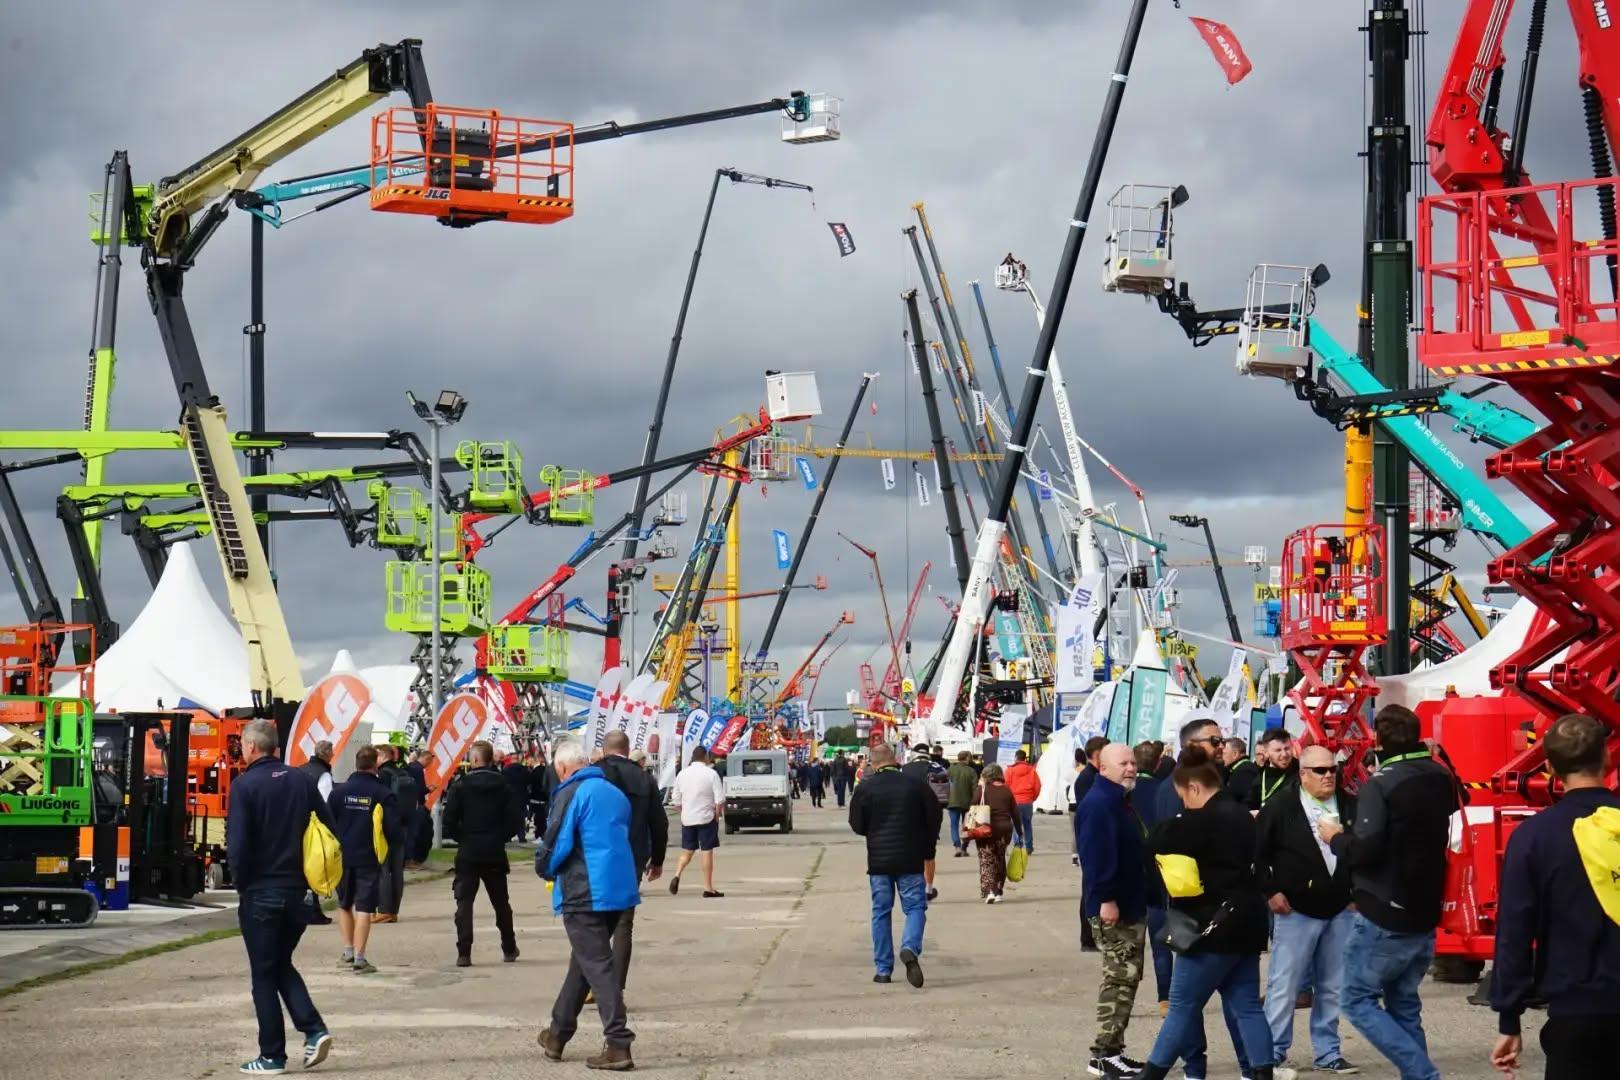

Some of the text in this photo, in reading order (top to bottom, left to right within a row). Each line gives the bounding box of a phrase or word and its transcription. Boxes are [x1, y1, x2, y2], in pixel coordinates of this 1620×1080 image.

[1593, 0, 1611, 29] MG
[1216, 35, 1241, 66] SANY
[424, 188, 450, 199] JLG
[1056, 390, 1080, 469] CLEAR VIEW ACCESS
[1470, 503, 1494, 527] IMER
[972, 576, 982, 597] SANY
[1170, 641, 1197, 656] IPAF
[1137, 677, 1158, 738] AREY
[594, 712, 608, 749] omax
[689, 714, 704, 737] CTE
[706, 720, 724, 741] CTE
[433, 700, 480, 779] JLG
